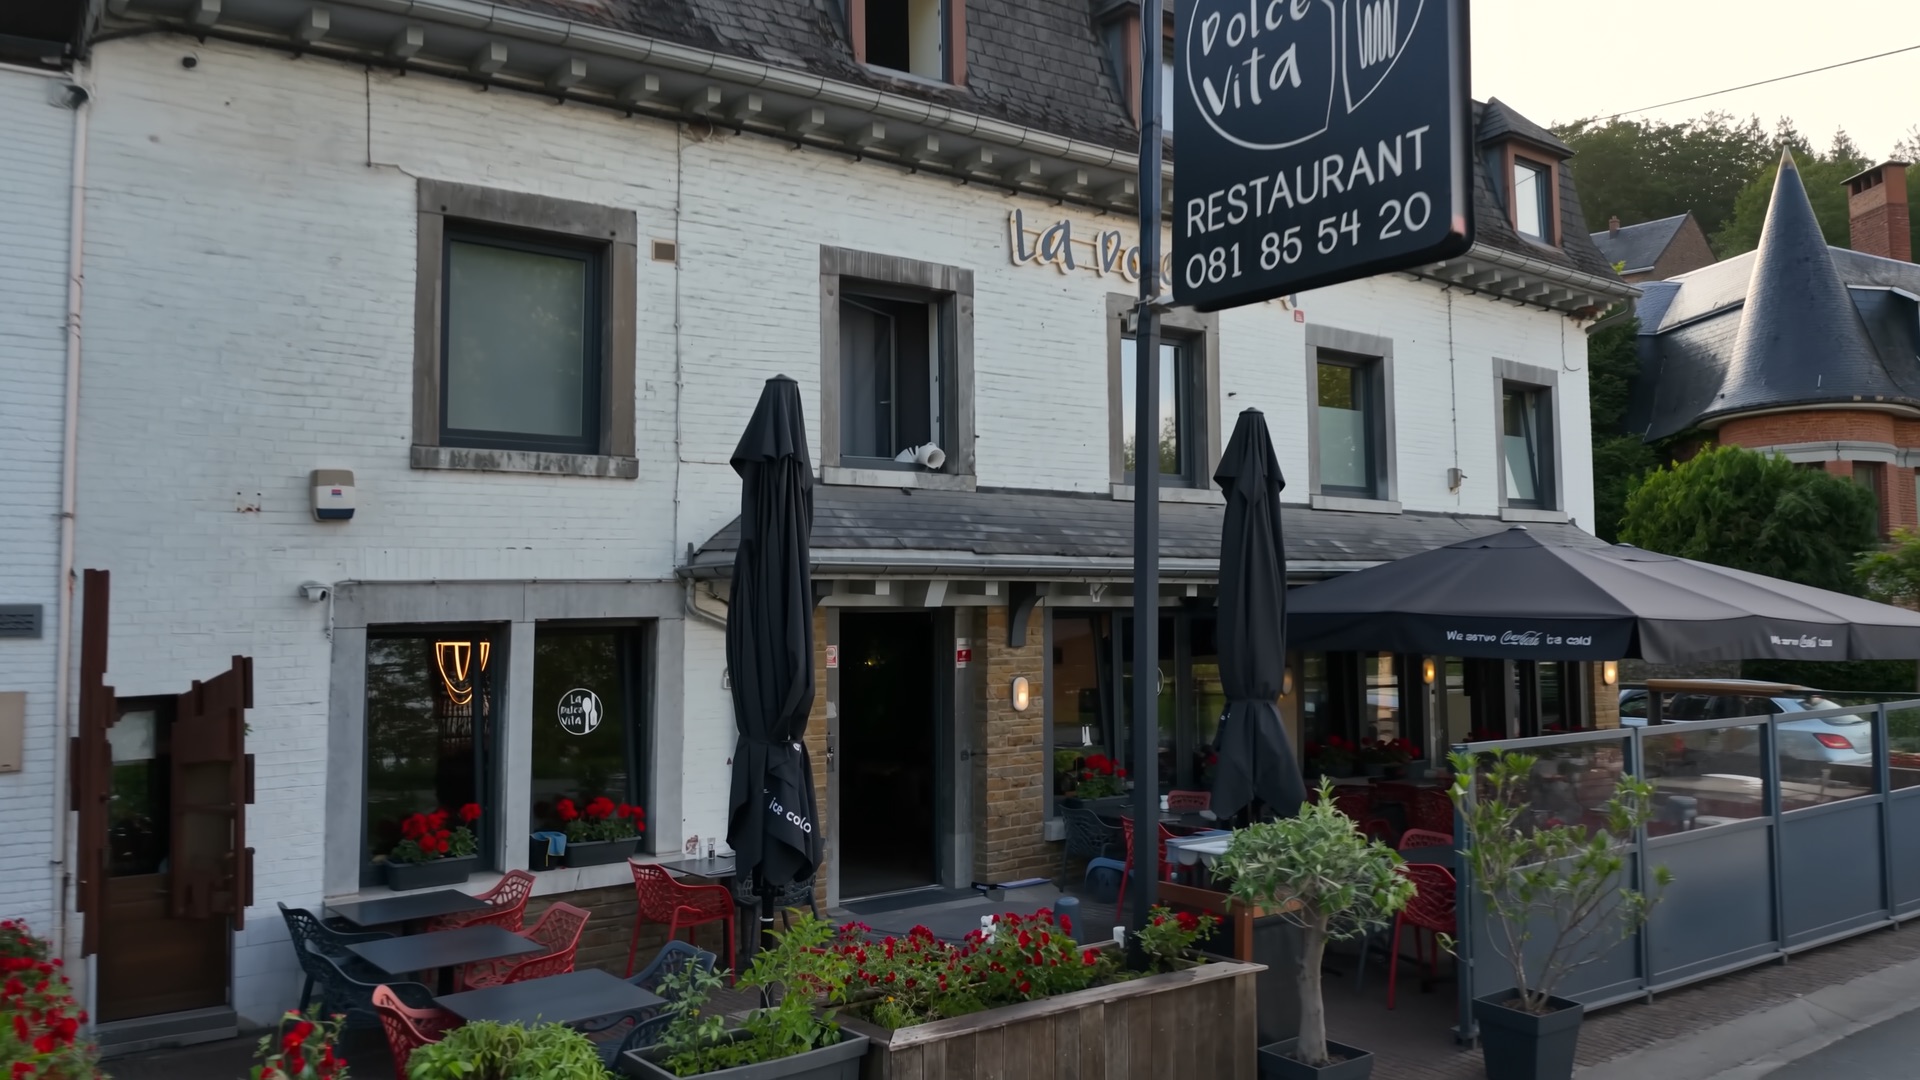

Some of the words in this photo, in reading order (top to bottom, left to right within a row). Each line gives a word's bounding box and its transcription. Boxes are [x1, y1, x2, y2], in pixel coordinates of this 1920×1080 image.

[1201, 0, 1311, 56] Dolce
[1202, 42, 1302, 116] Vita
[1187, 125, 1430, 238] RESTAURANT
[1011, 208, 1075, 275] La
[1185, 242, 1242, 289] 081
[1260, 226, 1303, 271] 85
[1317, 209, 1361, 254] 54
[1379, 191, 1431, 240] 20
